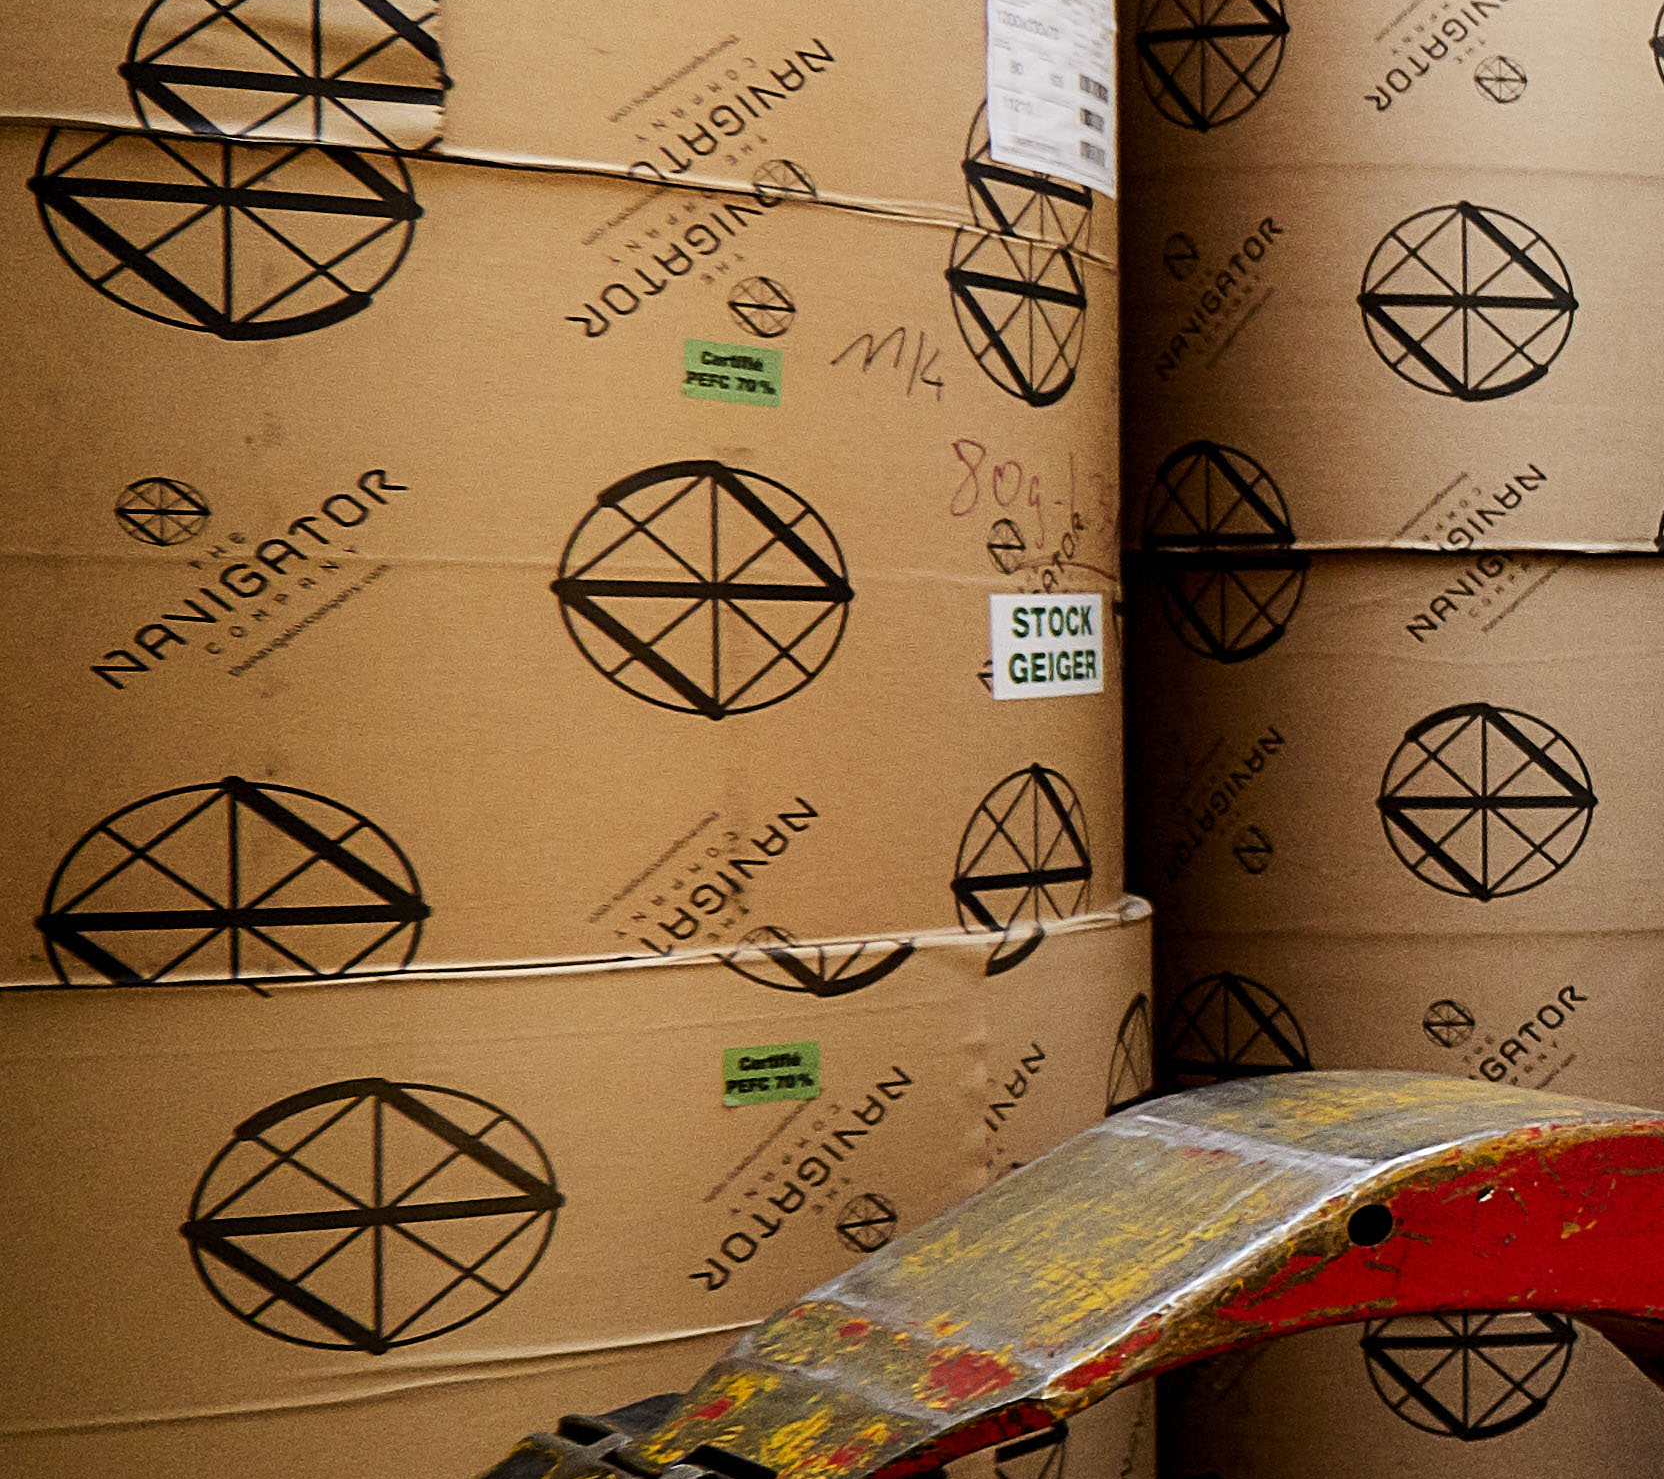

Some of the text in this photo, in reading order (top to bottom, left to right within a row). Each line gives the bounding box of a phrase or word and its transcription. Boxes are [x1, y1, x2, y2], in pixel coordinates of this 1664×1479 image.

[1155, 215, 1285, 383] NAVIGATOR
[90, 469, 408, 689] NAVIGATOR
[191, 530, 247, 570] THE
[206, 547, 359, 656] COMPANY
[1008, 650, 1097, 685] GEIGER
[1011, 605, 1094, 637] STOCK
[690, 1066, 915, 1293] NAVIGATOR
